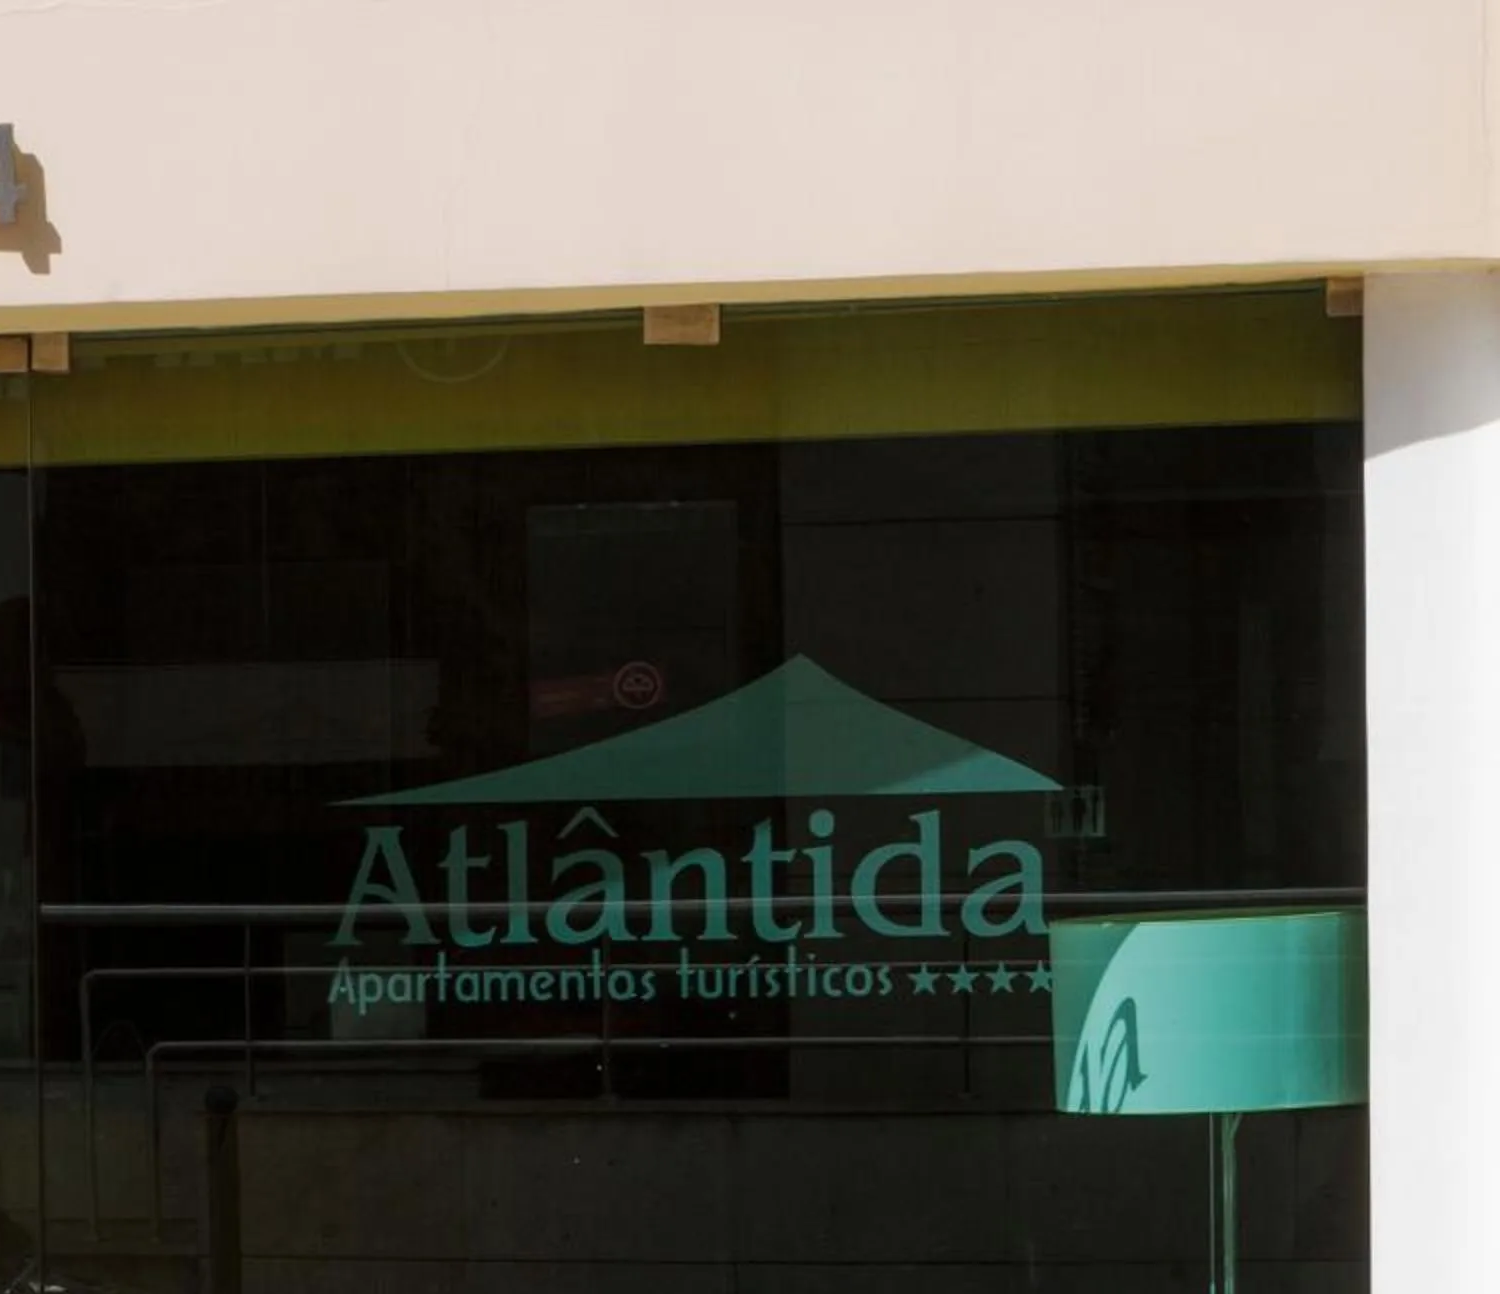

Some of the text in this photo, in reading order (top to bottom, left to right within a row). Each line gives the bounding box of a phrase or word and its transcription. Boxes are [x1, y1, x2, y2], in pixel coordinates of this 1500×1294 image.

[325, 805, 1050, 947] Atlântida
[328, 944, 894, 1016] Apartamentos turísticos
